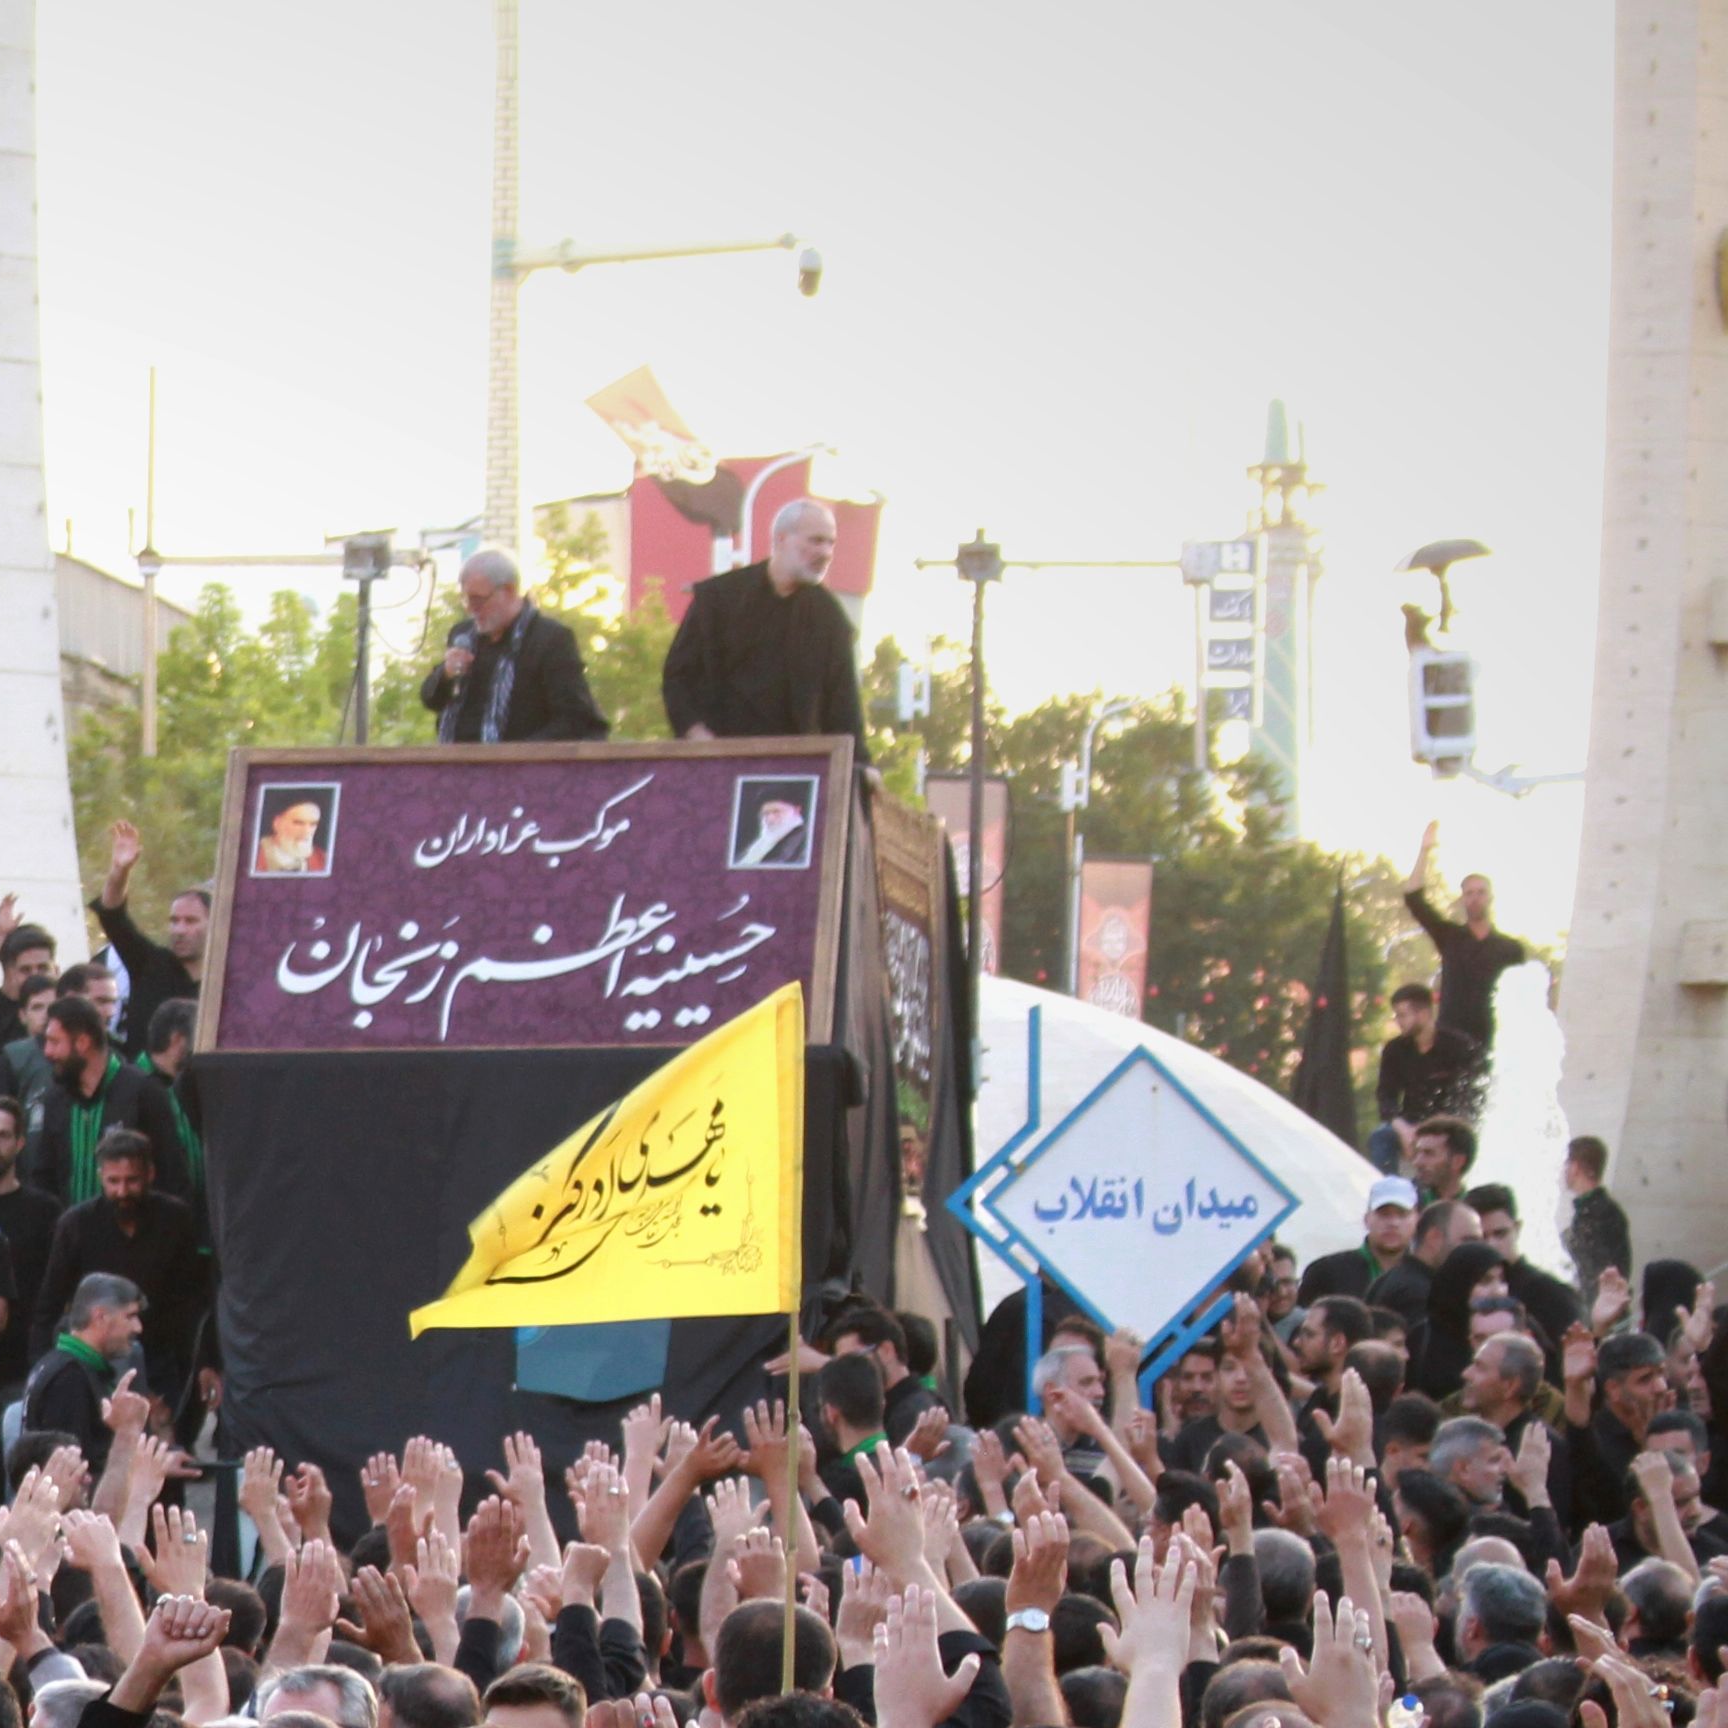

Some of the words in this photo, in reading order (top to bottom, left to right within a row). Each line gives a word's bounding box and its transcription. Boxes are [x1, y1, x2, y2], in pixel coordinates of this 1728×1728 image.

[413, 806, 541, 869] عزاداران
[534, 774, 655, 868] موکب
[276, 916, 460, 1029] زنجان
[441, 893, 676, 1041] اعظم
[1033, 1175, 1144, 1235] انقلاب
[1152, 1175, 1259, 1236] میدان
